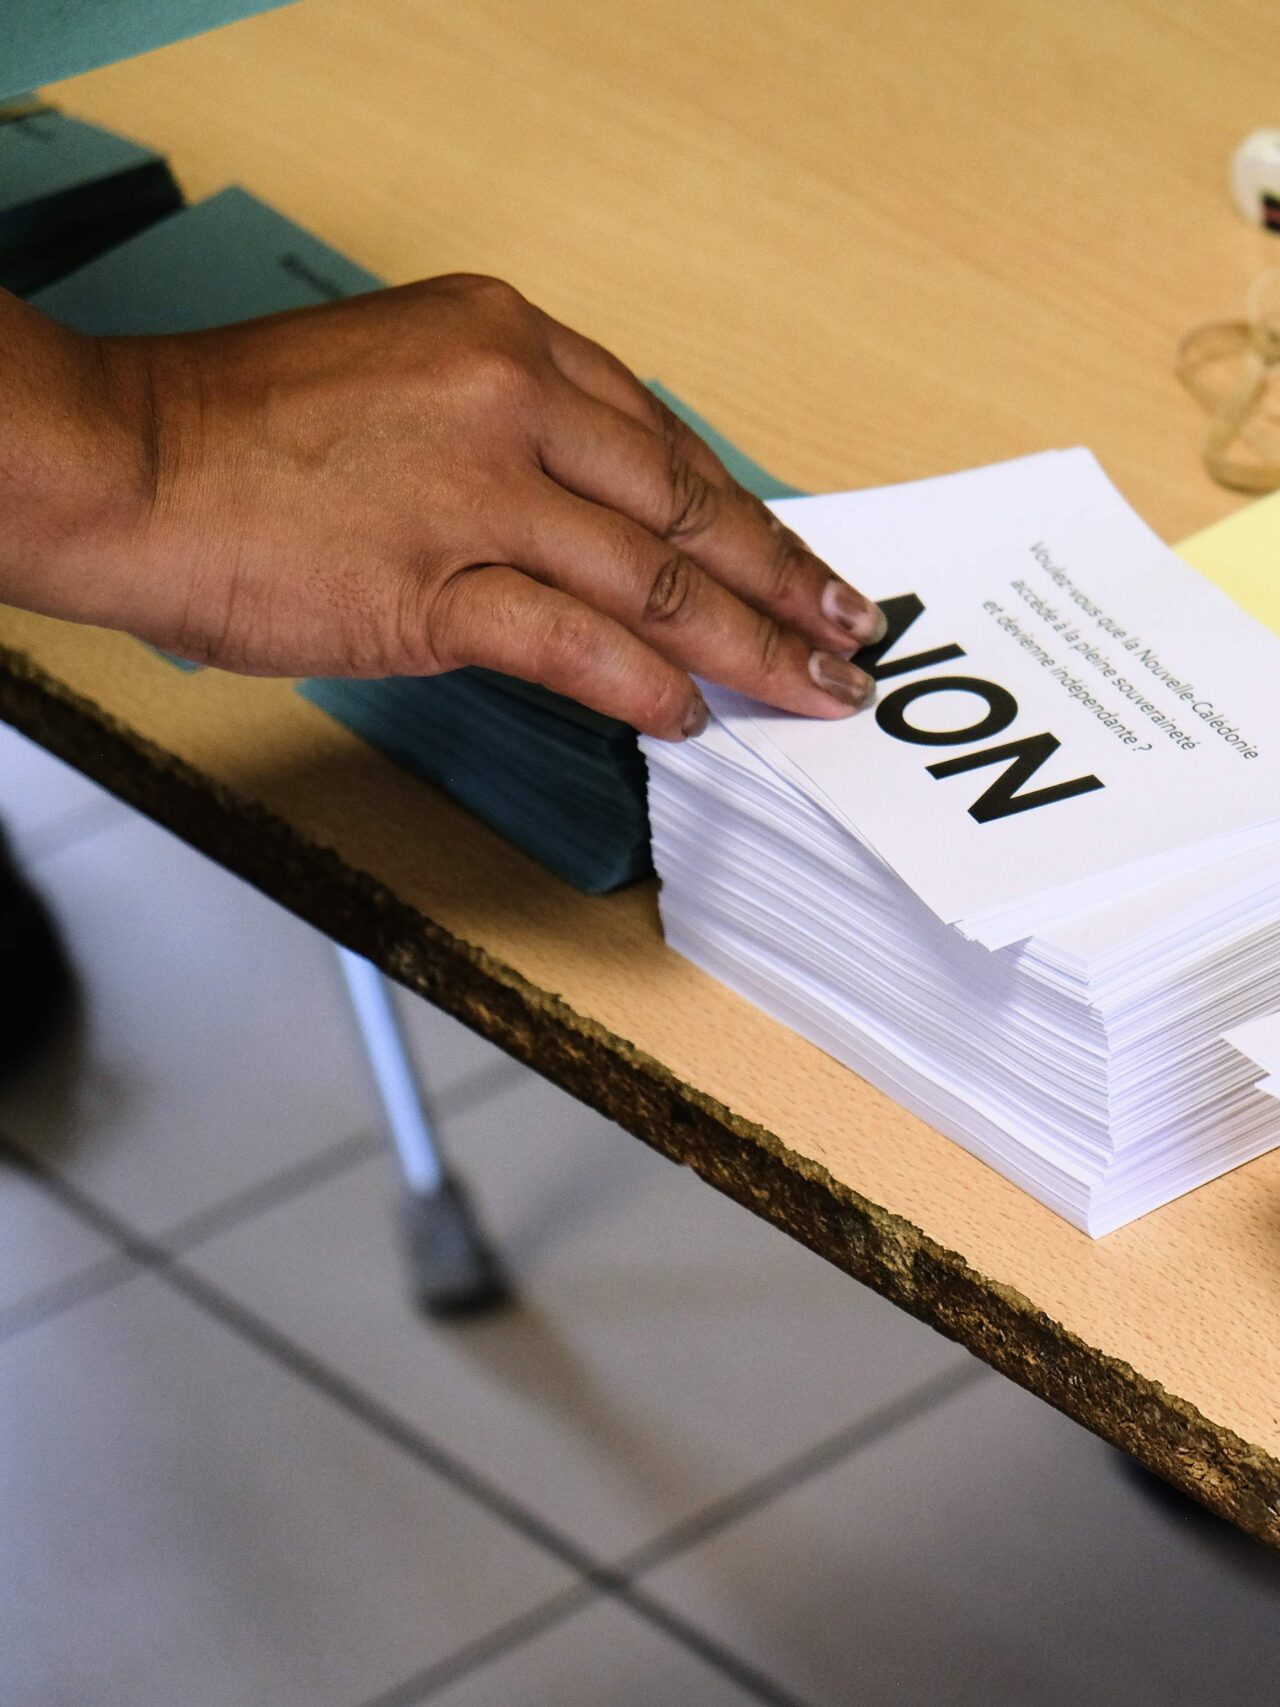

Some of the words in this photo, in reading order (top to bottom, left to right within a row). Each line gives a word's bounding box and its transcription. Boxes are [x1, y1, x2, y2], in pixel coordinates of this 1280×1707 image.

[1010, 579, 1058, 622] accède
[1052, 621, 1070, 632] à
[1030, 541, 1102, 618] Voulez-vous
[1098, 617, 1126, 640] que
[1121, 637, 1140, 651] la
[1134, 648, 1259, 760] Nouvelle-Calédonie
[1064, 629, 1079, 643] la
[1069, 642, 1117, 677] pleine
[983, 600, 1003, 616] et
[997, 615, 1055, 668] devienne
[1050, 666, 1138, 745] indépendante
[850, 592, 1106, 824] NON
[1112, 677, 1201, 750] souveraineté
